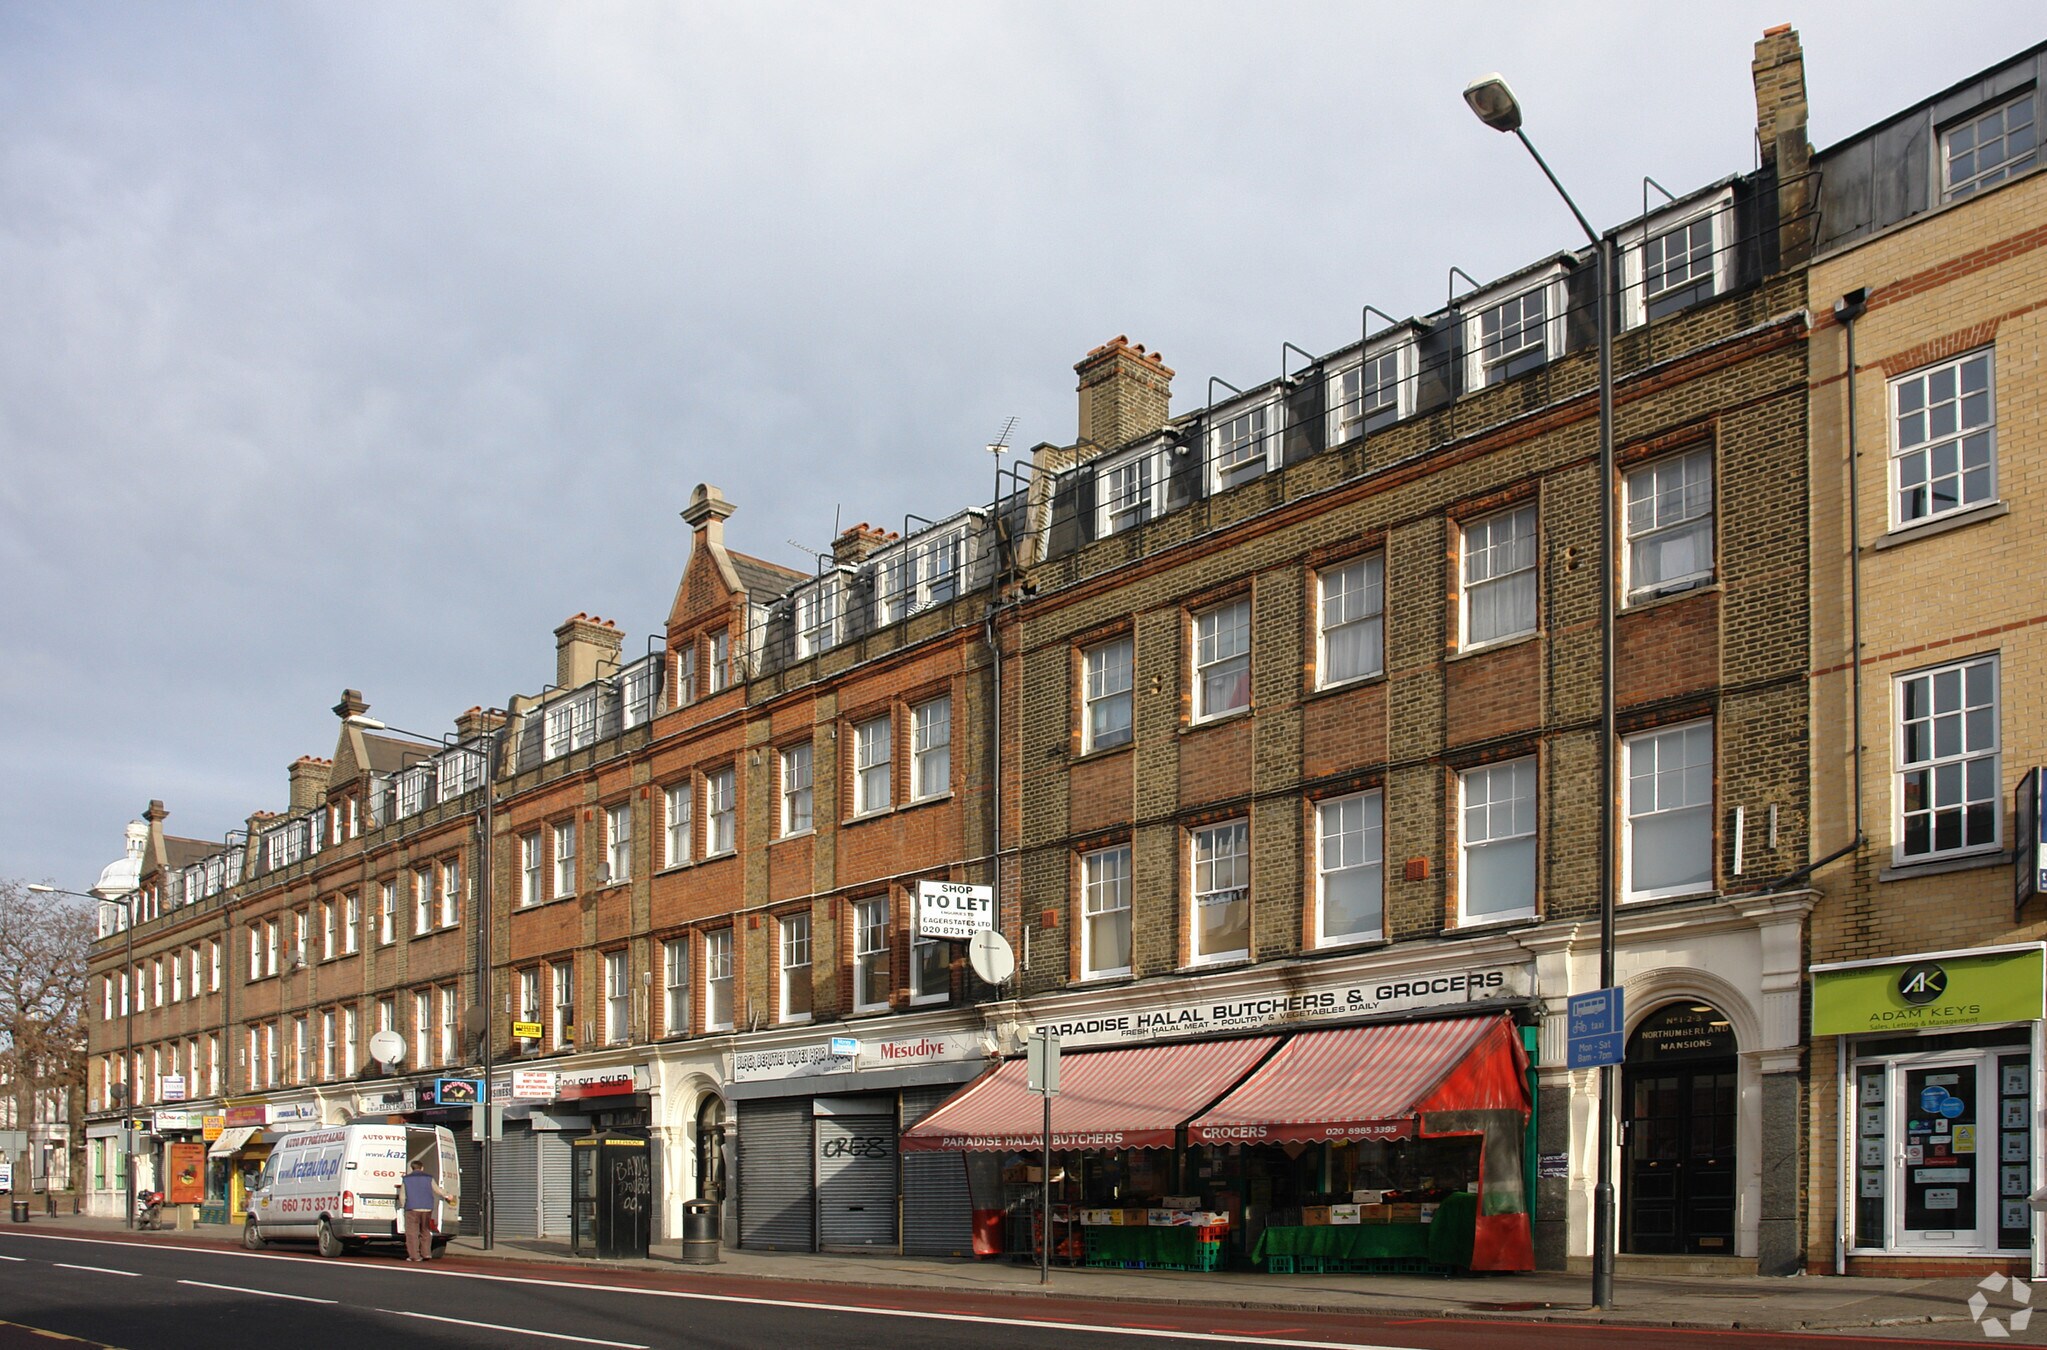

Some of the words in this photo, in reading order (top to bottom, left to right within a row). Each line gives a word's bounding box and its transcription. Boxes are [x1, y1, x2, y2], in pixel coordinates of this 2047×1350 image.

[942, 884, 973, 894] SHOP
[924, 894, 950, 908] TO
[956, 897, 990, 911] LET
[923, 917, 976, 926] EAGERSTATES
[943, 927, 964, 935] 8731
[1036, 1016, 1129, 1036] PARADISE
[1137, 1008, 1204, 1028] HALAL
[1212, 992, 1335, 1020] BUTCHERS
[1346, 989, 1364, 1004] &
[1375, 971, 1504, 1001] GROCERS
[1120, 1028, 1149, 1037] FRESH
[1151, 1024, 1181, 1034] HALAL
[1184, 1021, 1210, 1031] MEAT
[1221, 1014, 1264, 1026] POULTRY
[1267, 1013, 1275, 1021] &
[1280, 1005, 1346, 1019] VEGETABLES
[1349, 1001, 1380, 1012] DAILY
[1869, 1010, 1922, 1022] ADAM
[1931, 1004, 1981, 1017] KEYS
[1591, 1020, 1605, 1030] taxi
[1869, 1023, 1891, 1031] Sales,
[1892, 1019, 1919, 1030] Letting
[1919, 1019, 1926, 1027] &
[1928, 1016, 1978, 1027] Management
[1578, 1043, 1593, 1052] Mon
[1598, 1040, 1612, 1049] Sat
[1660, 1039, 1712, 1050] MANSIONS
[1577, 1054, 1592, 1063] 8am
[1598, 1051, 1613, 1061] 7pm
[562, 1077, 594, 1090] POLSKI
[600, 1074, 629, 1088] SKLEP
[1202, 1126, 1268, 1139] GROCERS
[1325, 1127, 1345, 1136] 020
[1347, 1126, 1372, 1135] 8985
[1373, 1125, 1397, 1134] 3395
[942, 1137, 1002, 1147] PARADISE
[1005, 1135, 1045, 1146] HALAL
[1052, 1132, 1124, 1145] BUTCHERS
[278, 1152, 343, 1181] www.kazauto.pl
[282, 1199, 299, 1212] 660
[301, 1198, 312, 1212] 73
